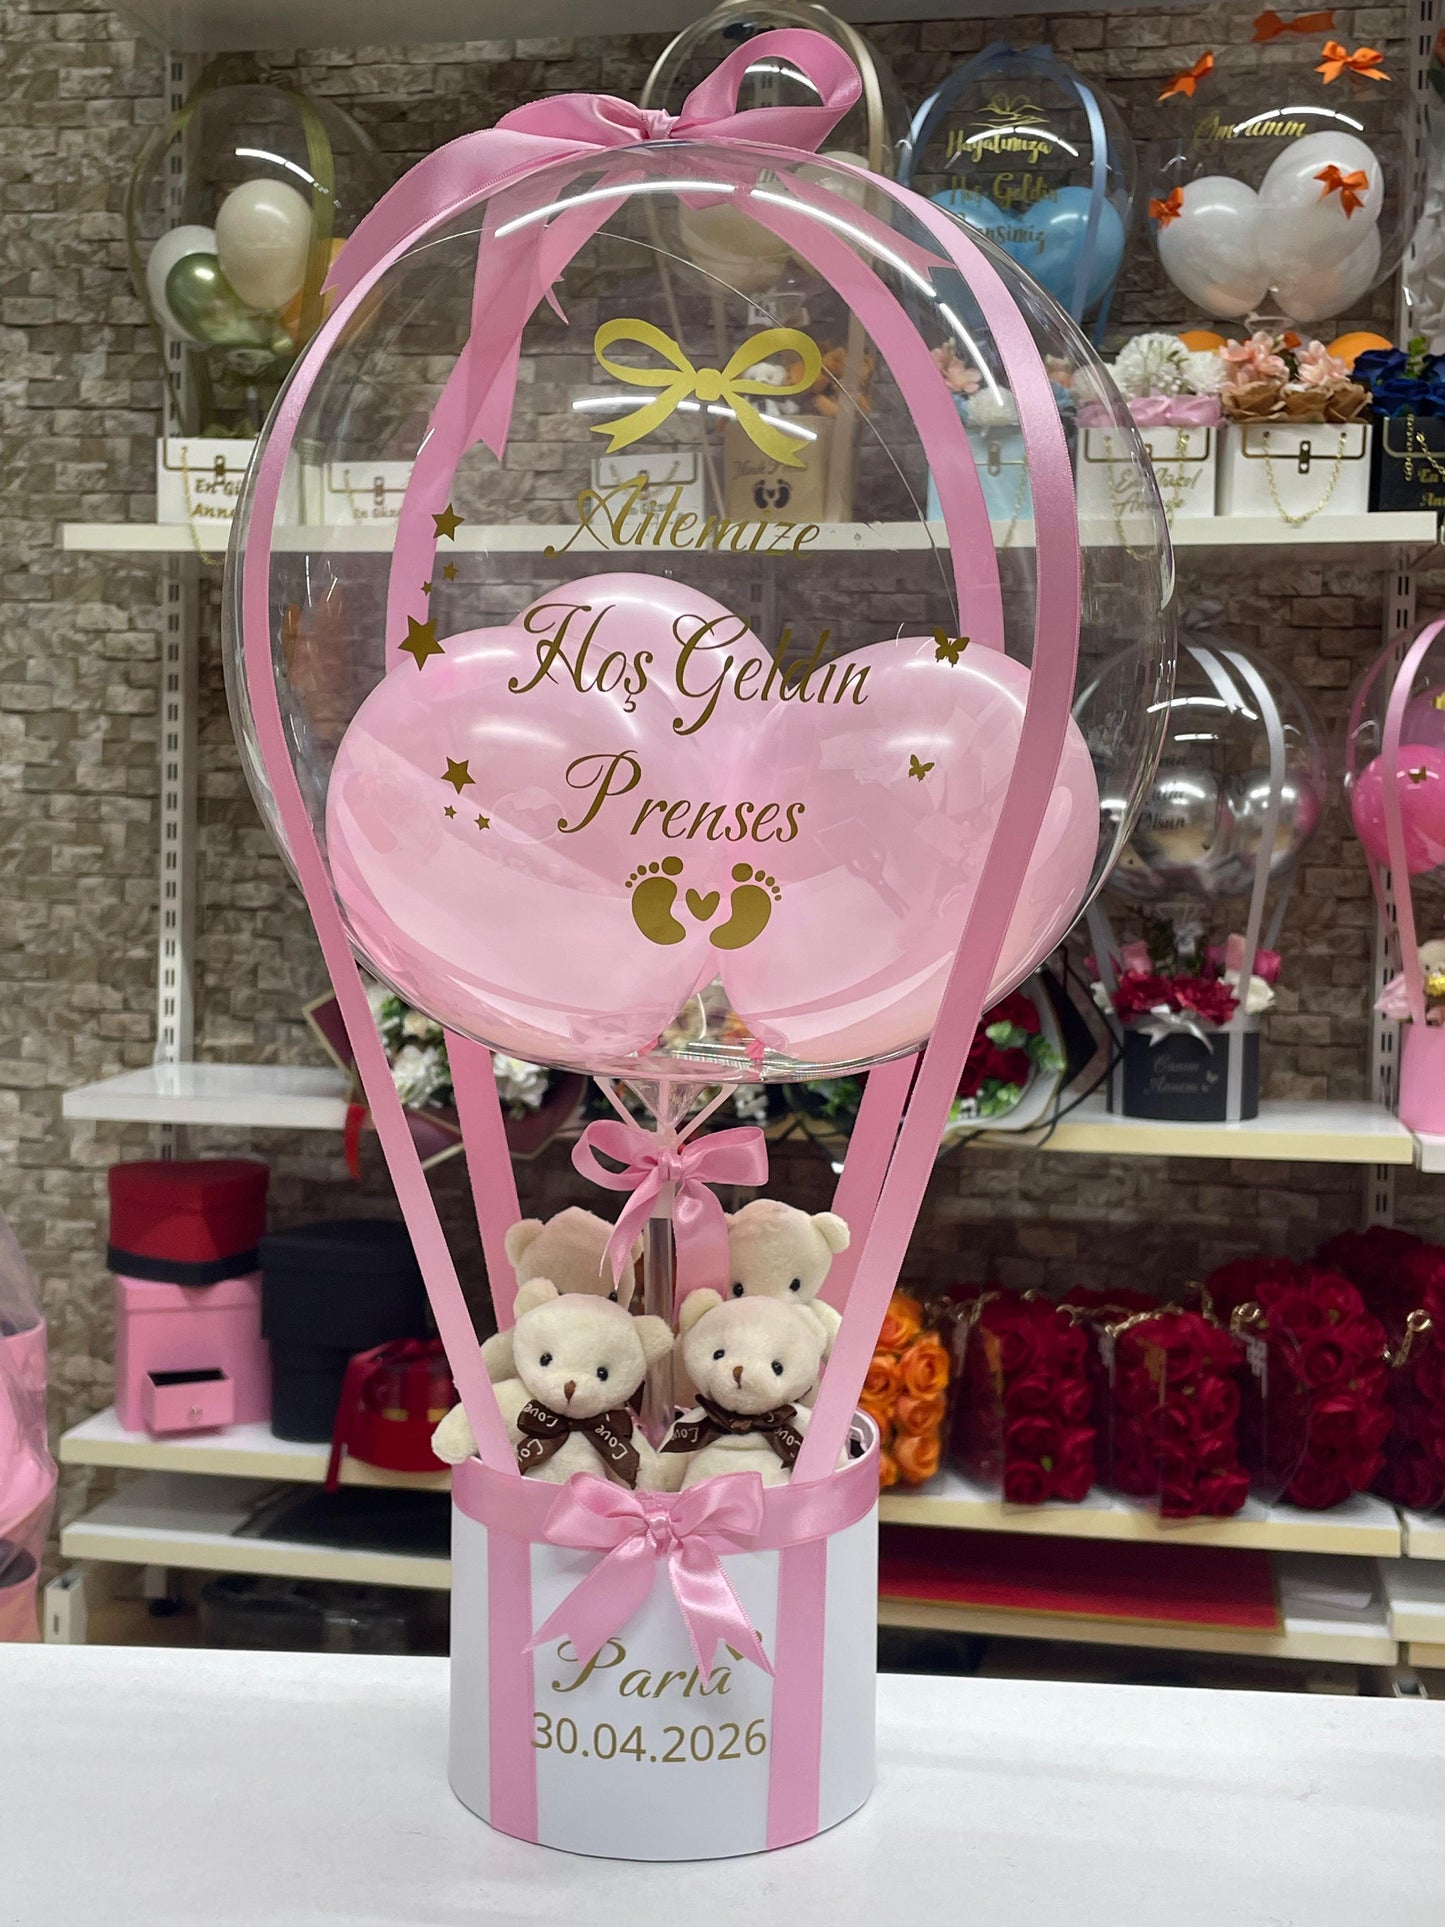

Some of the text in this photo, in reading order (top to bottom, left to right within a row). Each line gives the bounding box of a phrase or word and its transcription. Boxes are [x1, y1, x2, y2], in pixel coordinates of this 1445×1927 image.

[544, 475, 821, 559] Ailemize
[508, 603, 873, 736] Hoş Geldin
[557, 749, 806, 842] Prenses
[523, 1403, 558, 1427] Love
[594, 1424, 628, 1460] Love
[531, 1711, 767, 1763] 30.04.2026
